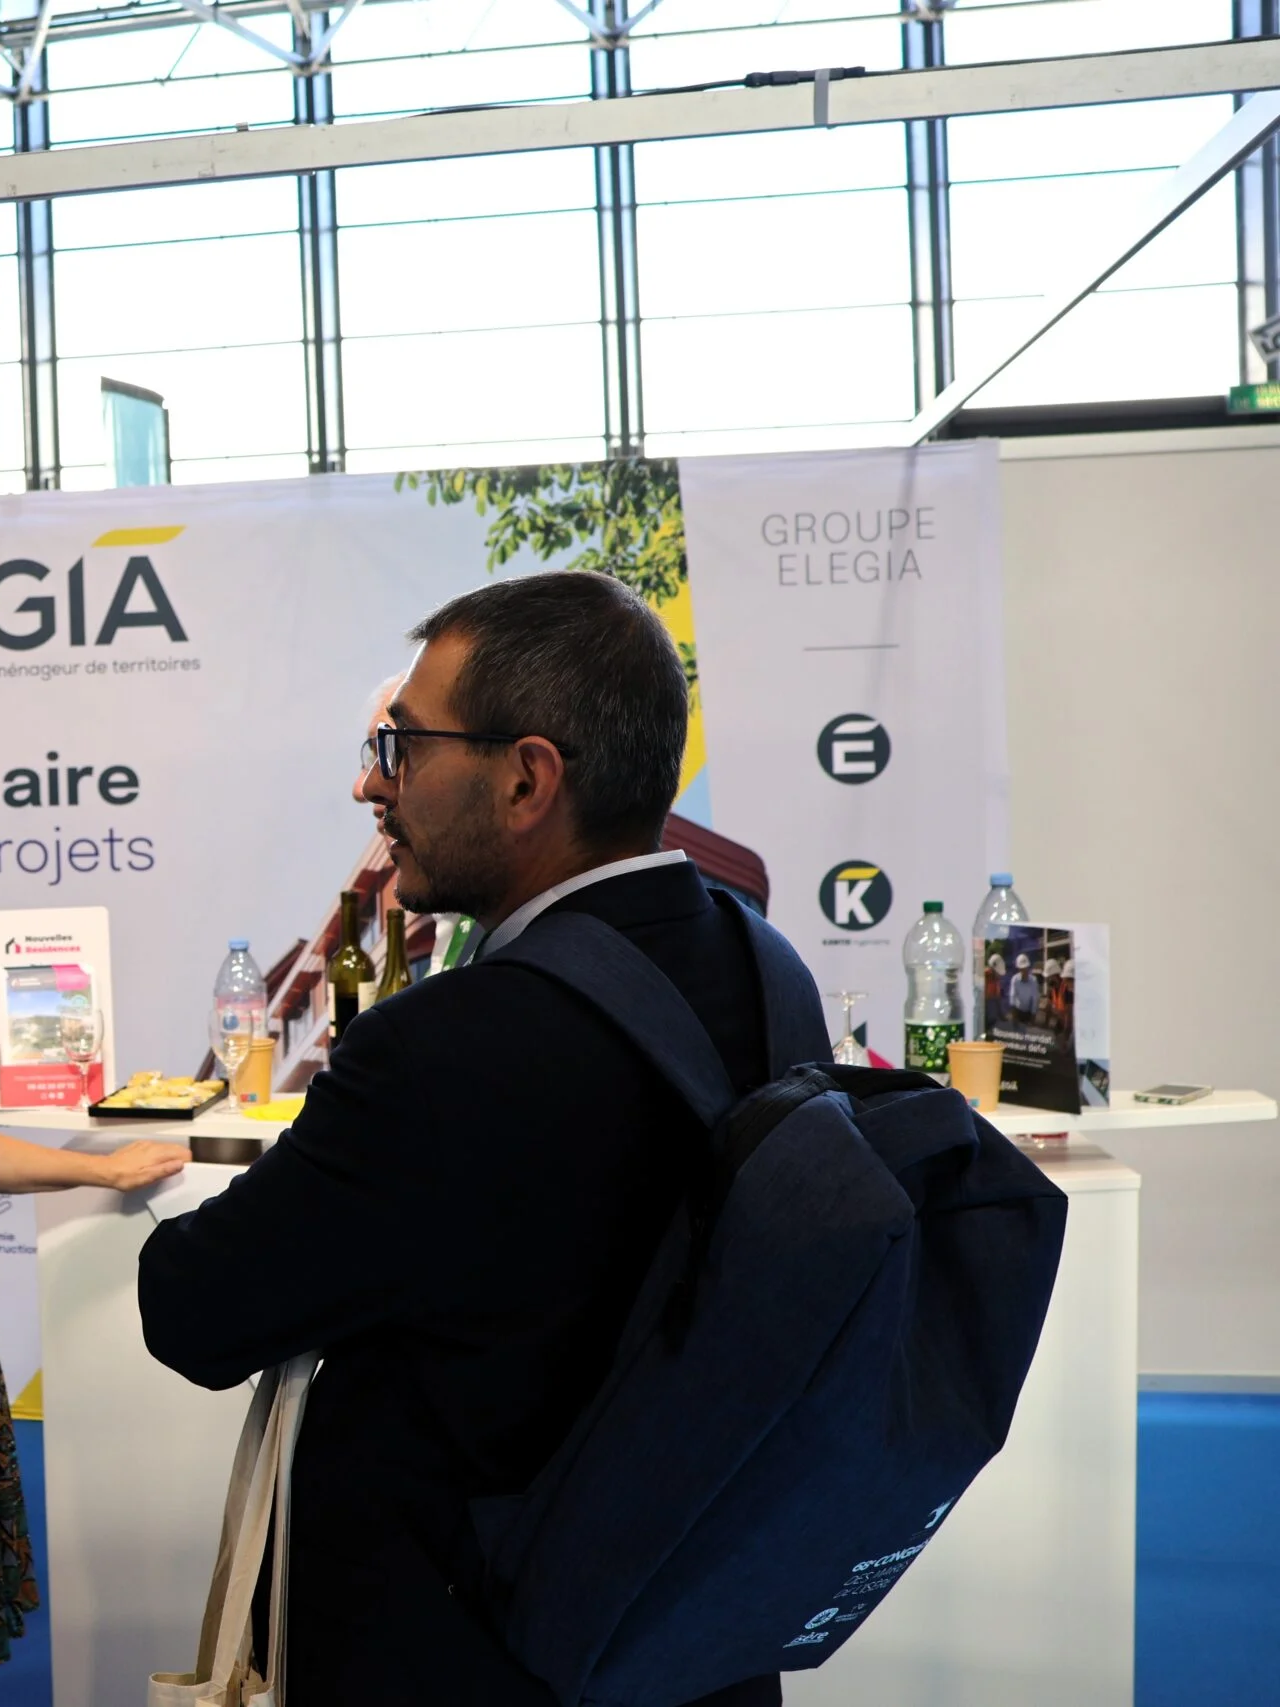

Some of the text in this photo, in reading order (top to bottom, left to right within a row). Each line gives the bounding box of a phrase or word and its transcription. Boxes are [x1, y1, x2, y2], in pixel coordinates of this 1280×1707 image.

[761, 506, 937, 546] GROUPE
[777, 549, 923, 586] ELEGIA
[84, 659, 108, 675] de
[112, 656, 201, 674] territoires
